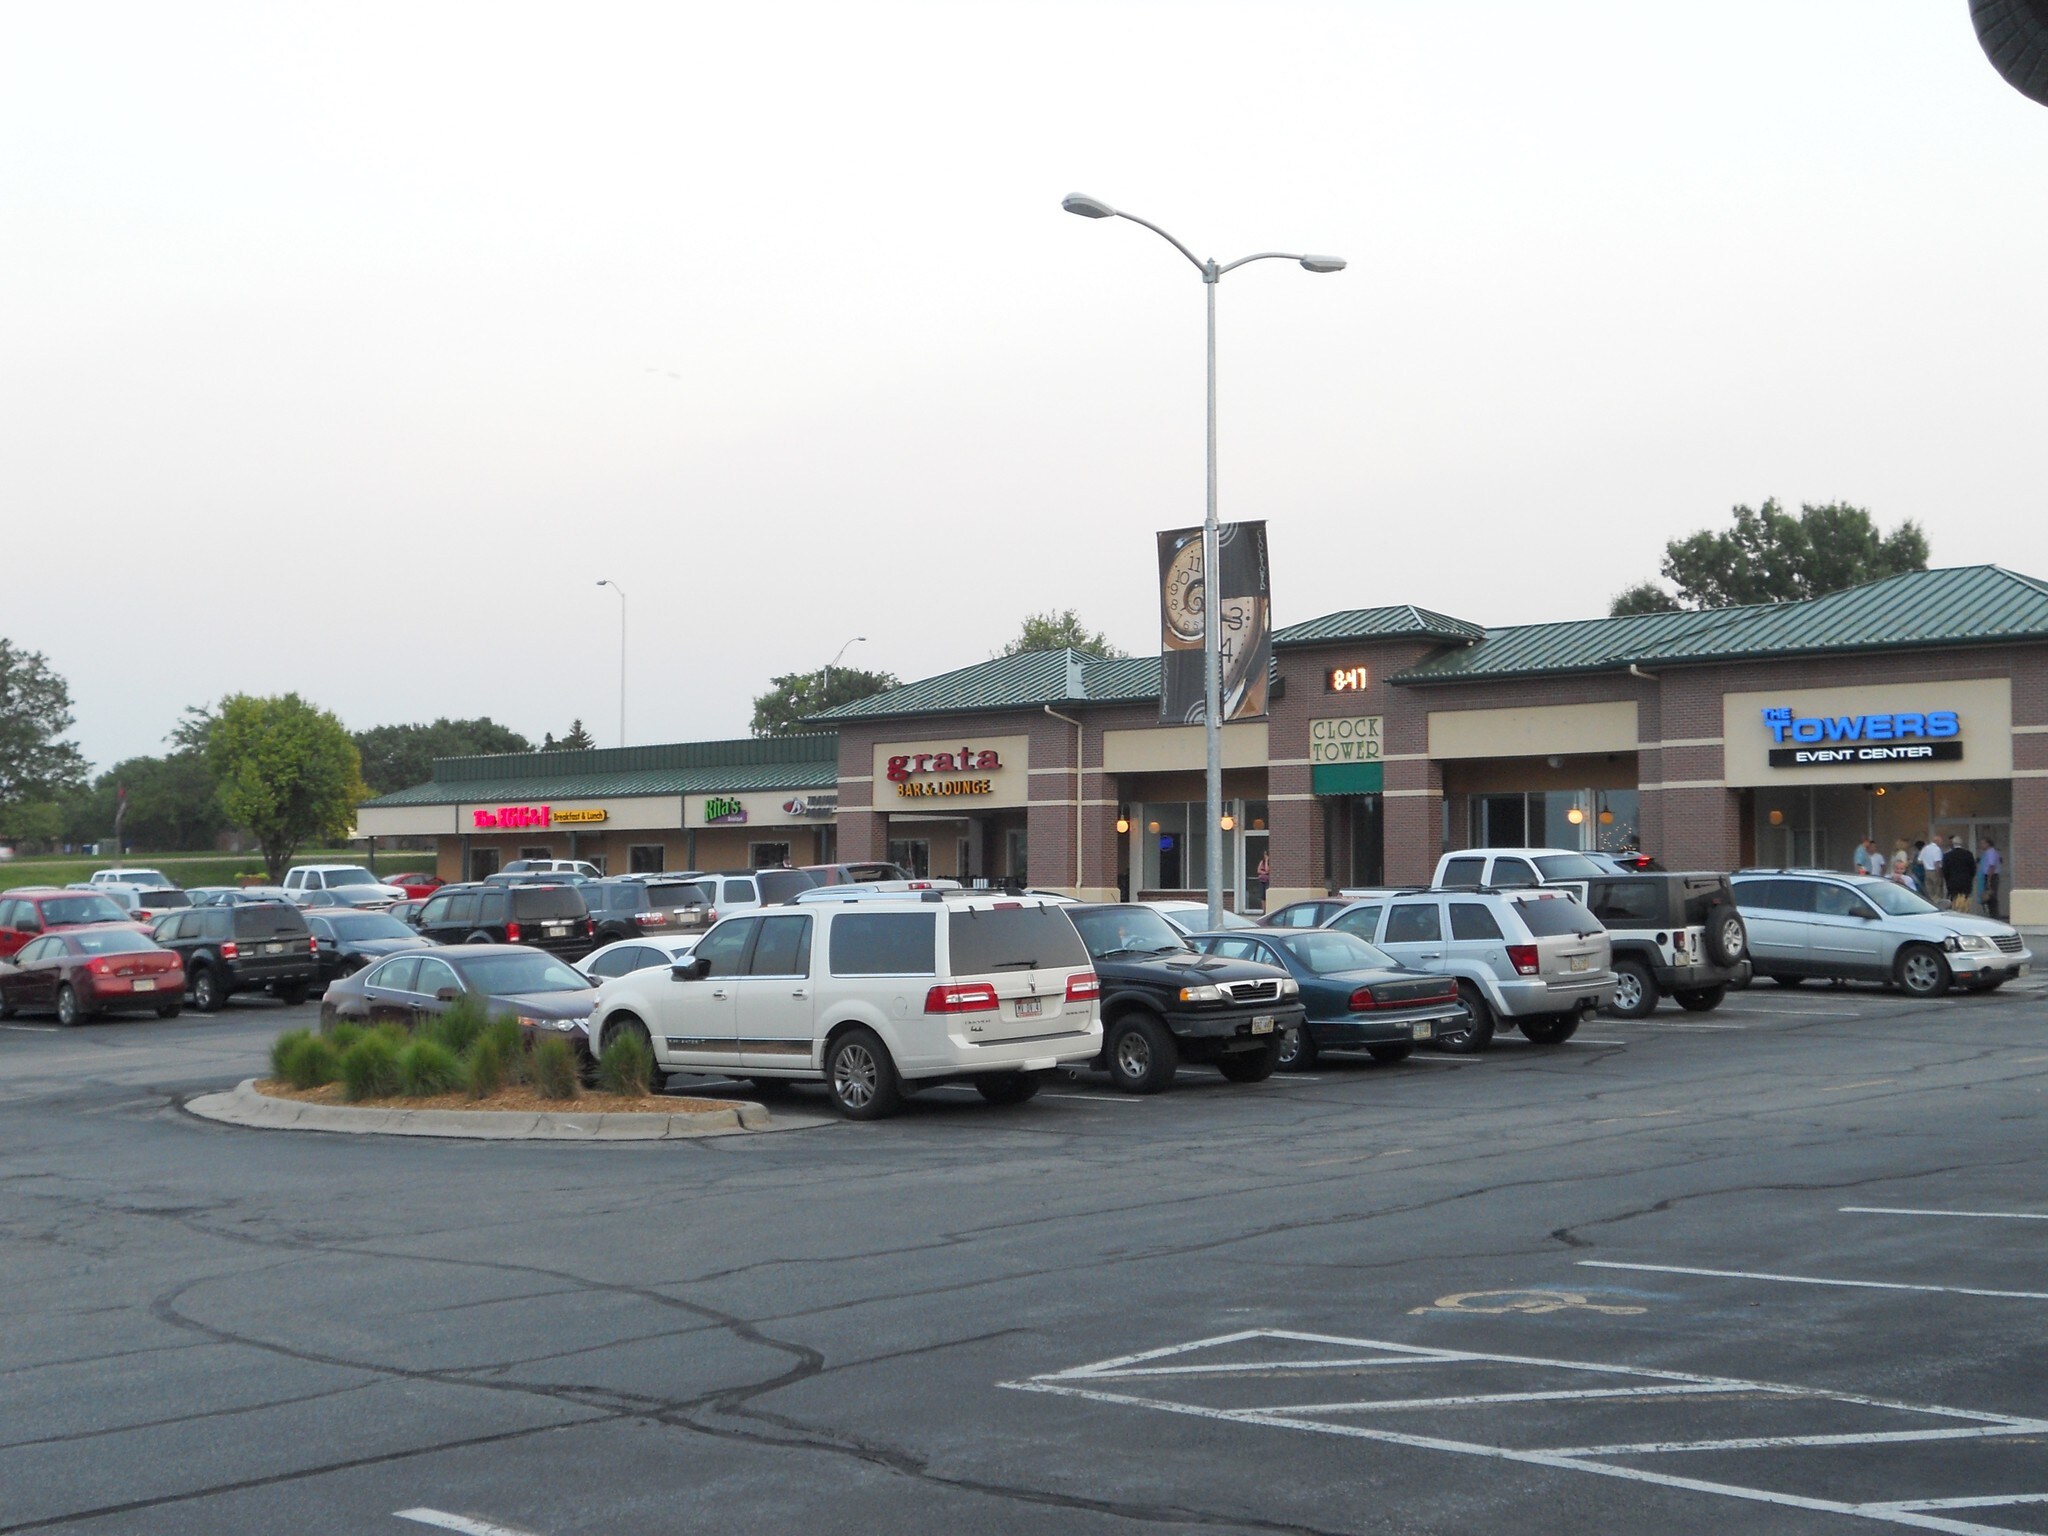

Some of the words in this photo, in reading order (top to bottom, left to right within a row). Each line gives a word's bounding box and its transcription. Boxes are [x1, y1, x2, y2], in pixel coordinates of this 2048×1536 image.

[1176, 569, 1190, 585] 10
[1170, 583, 1178, 595] 9
[1171, 599, 1178, 610] 8
[1228, 607, 1244, 630] 3
[1221, 637, 1234, 664] 4
[1762, 707, 1791, 721] THE
[1313, 719, 1379, 739] CLOCK
[1765, 711, 1960, 744] TOWERS
[1313, 741, 1379, 761] TOWER
[1796, 750, 1854, 762] EVENT
[1859, 746, 1932, 760] CENTER
[886, 746, 1003, 782] grata
[897, 782, 922, 798] BAR
[925, 783, 934, 796] &
[937, 779, 991, 796] LOUNGE
[553, 812, 581, 821] Breakfast
[587, 811, 603, 820] Lunch
[705, 797, 741, 821] Rita's
